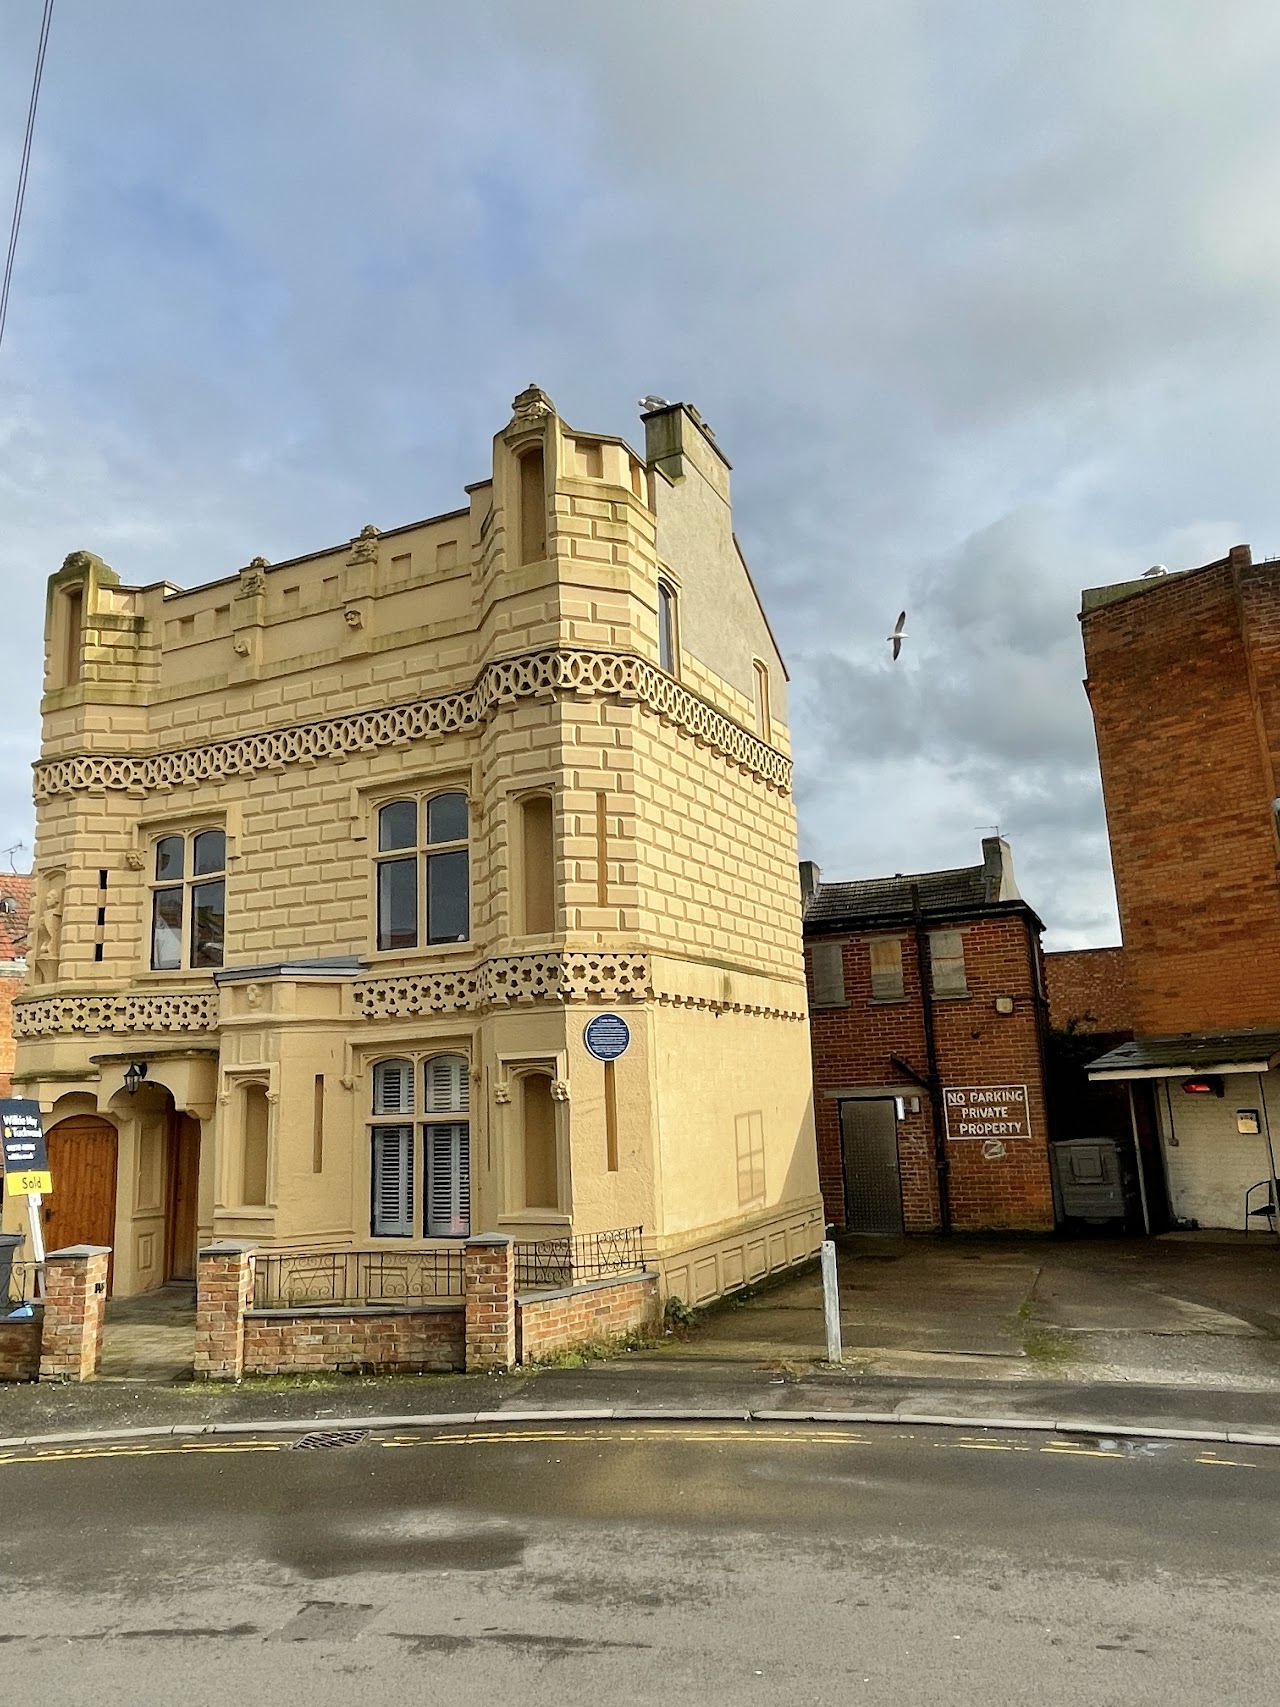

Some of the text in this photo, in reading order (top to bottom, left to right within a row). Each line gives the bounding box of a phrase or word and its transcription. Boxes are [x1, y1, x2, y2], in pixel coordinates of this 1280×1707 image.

[947, 1090, 1023, 1104] NO PARKING
[962, 1106, 1008, 1118] PRIVATE
[960, 1122, 1021, 1135] PROPERTY
[22, 1176, 42, 1189] Sold
